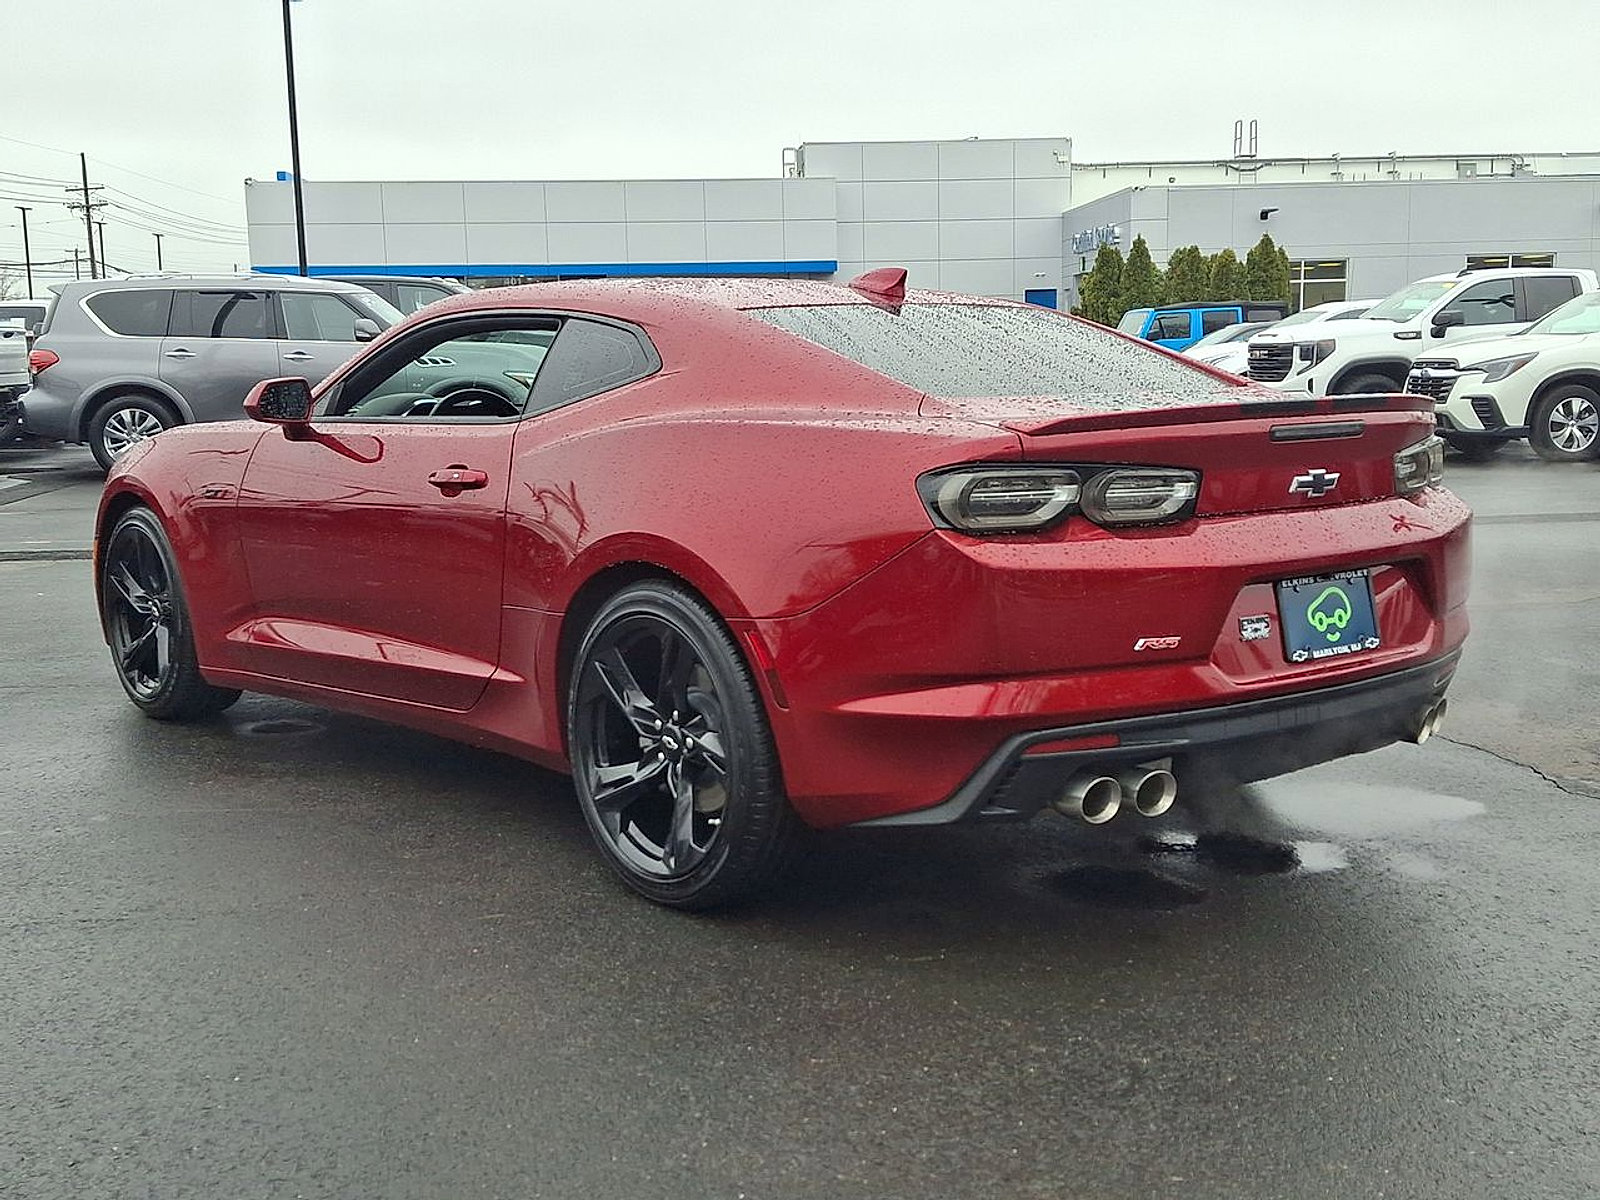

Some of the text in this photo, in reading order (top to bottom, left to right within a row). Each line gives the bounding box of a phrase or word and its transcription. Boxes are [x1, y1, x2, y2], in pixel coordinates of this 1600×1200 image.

[1282, 569, 1369, 588] ELKINS CVROLET
[1133, 636, 1182, 651] RS
